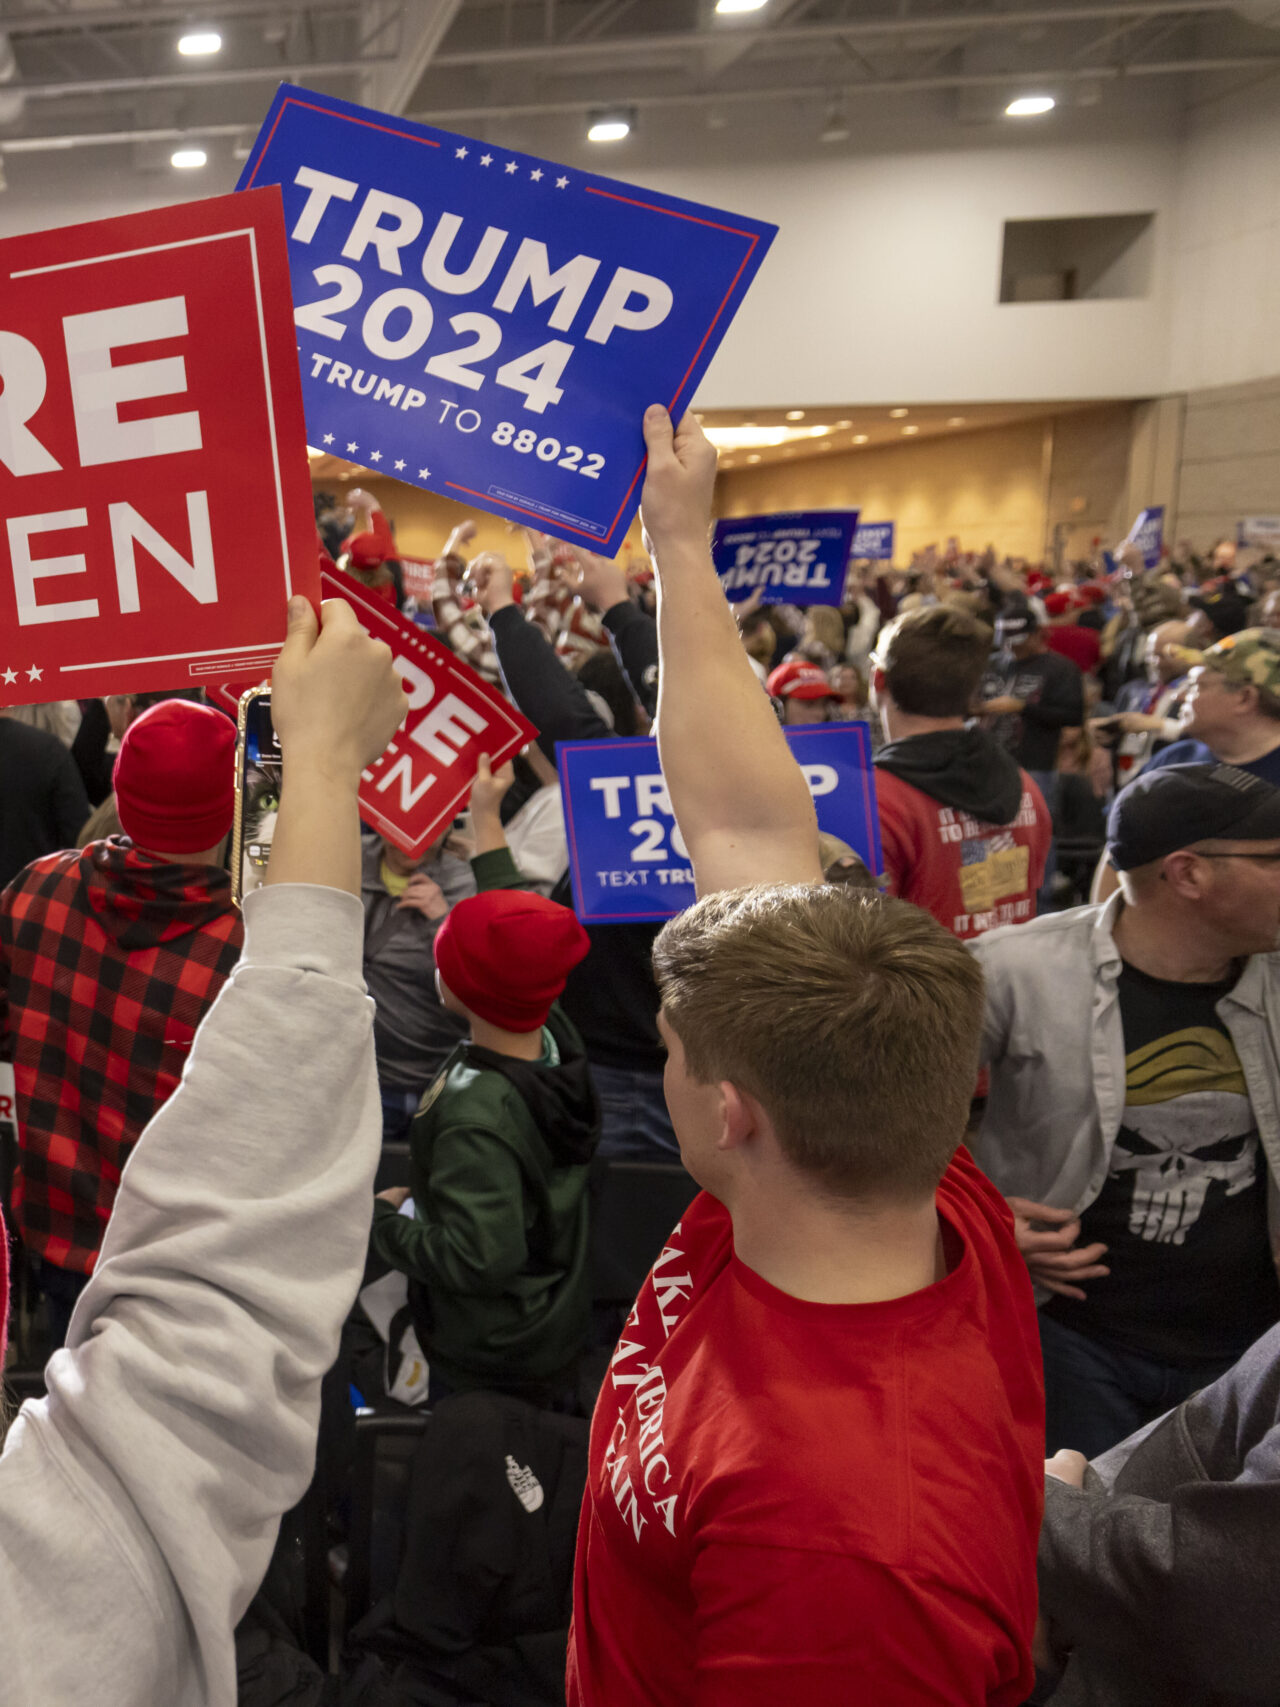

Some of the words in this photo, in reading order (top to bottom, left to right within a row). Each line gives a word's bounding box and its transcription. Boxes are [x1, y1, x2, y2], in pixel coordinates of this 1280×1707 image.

[291, 166, 673, 345] TRUMP
[294, 263, 575, 414] 2024
[310, 354, 427, 412] TRUMP
[438, 399, 482, 433] TO
[491, 422, 606, 480] 88022
[736, 540, 821, 565] 2024
[590, 764, 839, 818] TRP
[596, 870, 650, 887] TEXT
[656, 868, 695, 885] TRU
[606, 1407, 648, 1544] GAIN
